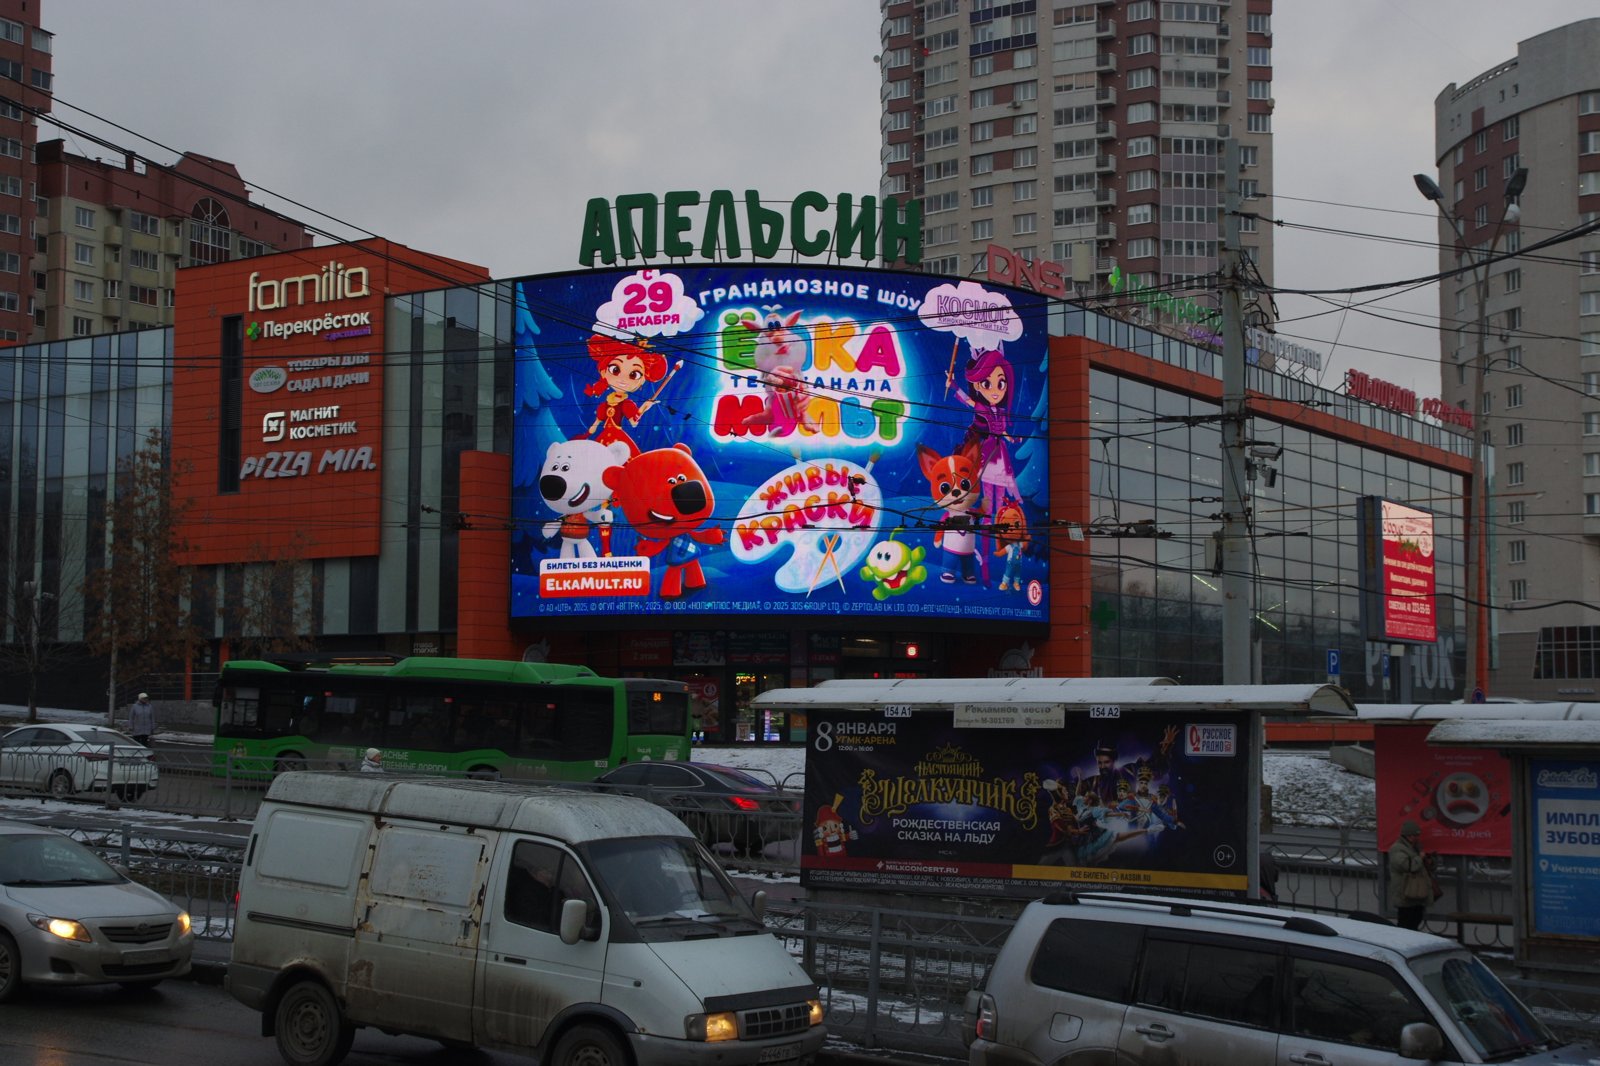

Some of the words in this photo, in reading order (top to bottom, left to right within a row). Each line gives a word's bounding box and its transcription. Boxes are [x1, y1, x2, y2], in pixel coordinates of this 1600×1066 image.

[580, 190, 920, 266] АПЕЛЬСИН
[643, 269, 653, 281] С
[988, 243, 1065, 297] DNS
[248, 260, 371, 312] familia
[699, 278, 870, 306] ГРАНДИОЗНОЕ
[876, 288, 921, 312] ШОУ
[623, 281, 673, 315] 29
[937, 294, 1010, 327] КОСМОС
[264, 312, 370, 340] Перекрёсток
[617, 314, 680, 330] ДЕКАБРЯ
[288, 357, 339, 372] ТОВАРЫ
[341, 352, 370, 367] ДЛЯ
[287, 378, 320, 392] САДА
[322, 376, 332, 388] И
[333, 371, 370, 388] ДАЧИ
[731, 376, 892, 392] ТЕАНАЛА
[290, 405, 340, 422] МАГНИТ
[290, 421, 358, 440] КОСМЕТИК
[240, 451, 313, 480] PIZZA
[737, 492, 876, 551] КРАСКИ
[547, 562, 580, 570] БИЛЕТЫ
[582, 561, 598, 569] БЕЗ
[600, 559, 643, 569] НАЦЕНКИ
[1330, 652, 1338, 673] P
[1365, 634, 1455, 690] РНОК
[886, 706, 899, 716] 154
[965, 704, 1019, 714] Рекламное
[1091, 707, 1105, 717] 154
[814, 721, 834, 752] 8
[836, 722, 896, 735] ЯНВАРЯ
[1202, 728, 1232, 740] РУССКОЕ
[1201, 740, 1224, 753] РАДИО
[914, 760, 985, 778] НАСТОЯЩИЙ
[876, 774, 1022, 820] ЩЕЛКУНЧИК
[892, 818, 1002, 833] РОЖДЕСТВЕНСКАЯ
[1547, 812, 1599, 826] ИМПЛ
[897, 830, 940, 843] СКАЗКА
[945, 832, 962, 843] НА
[964, 833, 997, 846] ЛЬДУ
[1546, 831, 1600, 845] ЗУБОВ
[886, 865, 959, 875] MILKCONCERT.RU
[1070, 870, 1082, 879] ВСЕ
[1084, 871, 1110, 880] БИЛЕТЫ
